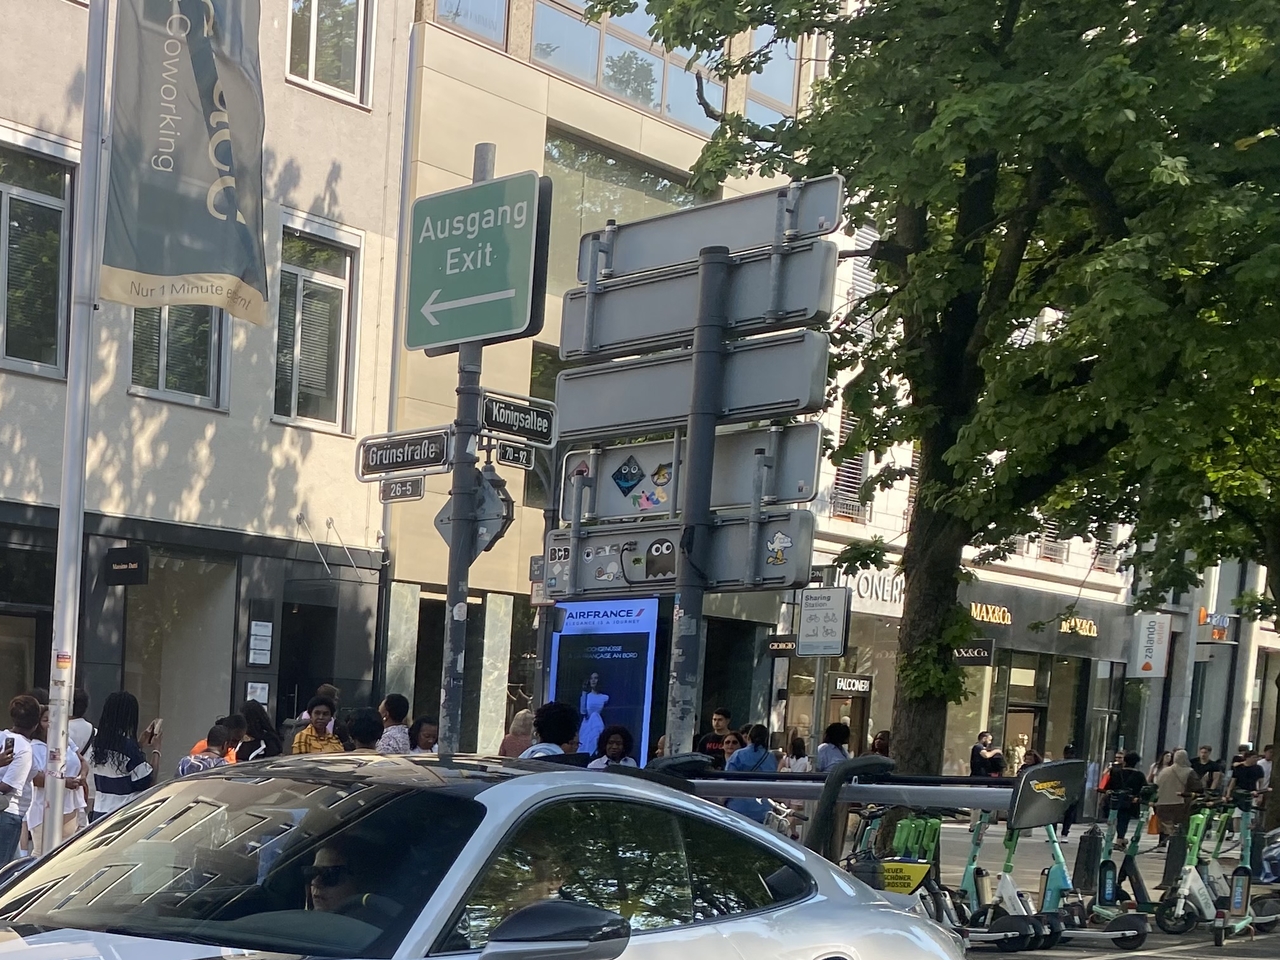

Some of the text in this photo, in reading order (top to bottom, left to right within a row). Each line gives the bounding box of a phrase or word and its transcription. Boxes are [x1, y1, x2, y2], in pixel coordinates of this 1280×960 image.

[151, 14, 191, 172] Coworking
[419, 201, 527, 243] Ausgang
[446, 242, 493, 275] Exit
[130, 281, 154, 297] Nur
[159, 285, 166, 296] 1
[171, 283, 223, 296] Minute
[492, 401, 549, 433] Königsallee
[370, 440, 436, 466] Grünstraße
[390, 484, 412, 496] 26-5
[805, 594, 831, 602] Sharing
[1143, 620, 1157, 660] zalando
[836, 677, 870, 692] FALCONERI
